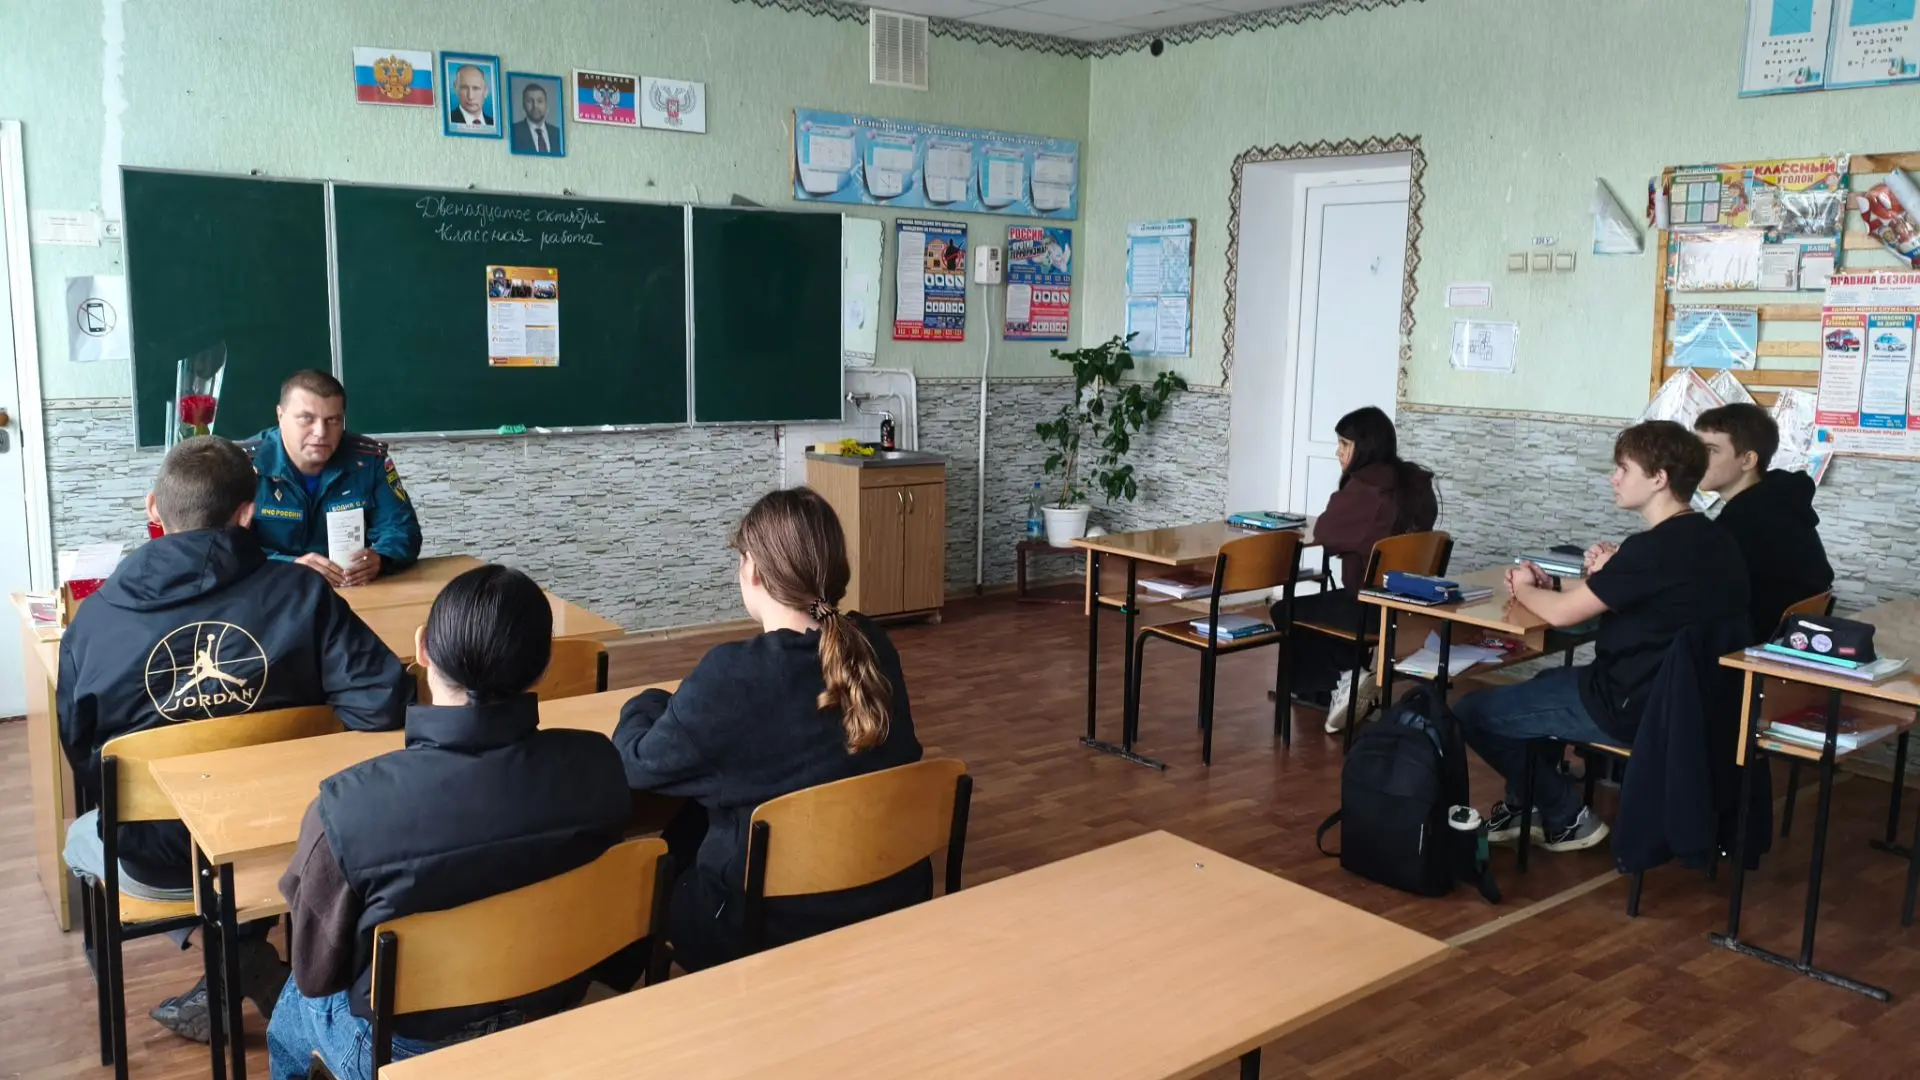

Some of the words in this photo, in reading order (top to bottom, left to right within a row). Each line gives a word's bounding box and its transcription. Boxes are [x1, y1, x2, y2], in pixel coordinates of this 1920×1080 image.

[1755, 159, 1836, 175] КЛАССНЫЙ
[1777, 174, 1814, 184] УГОЛОК
[536, 207, 606, 230] октября
[435, 222, 533, 243] Классная
[540, 229, 603, 252] работа
[1010, 227, 1044, 241] РОССИЯ
[1831, 275, 1877, 286] ПРАВИЛА
[164, 687, 253, 712] JORDAN
